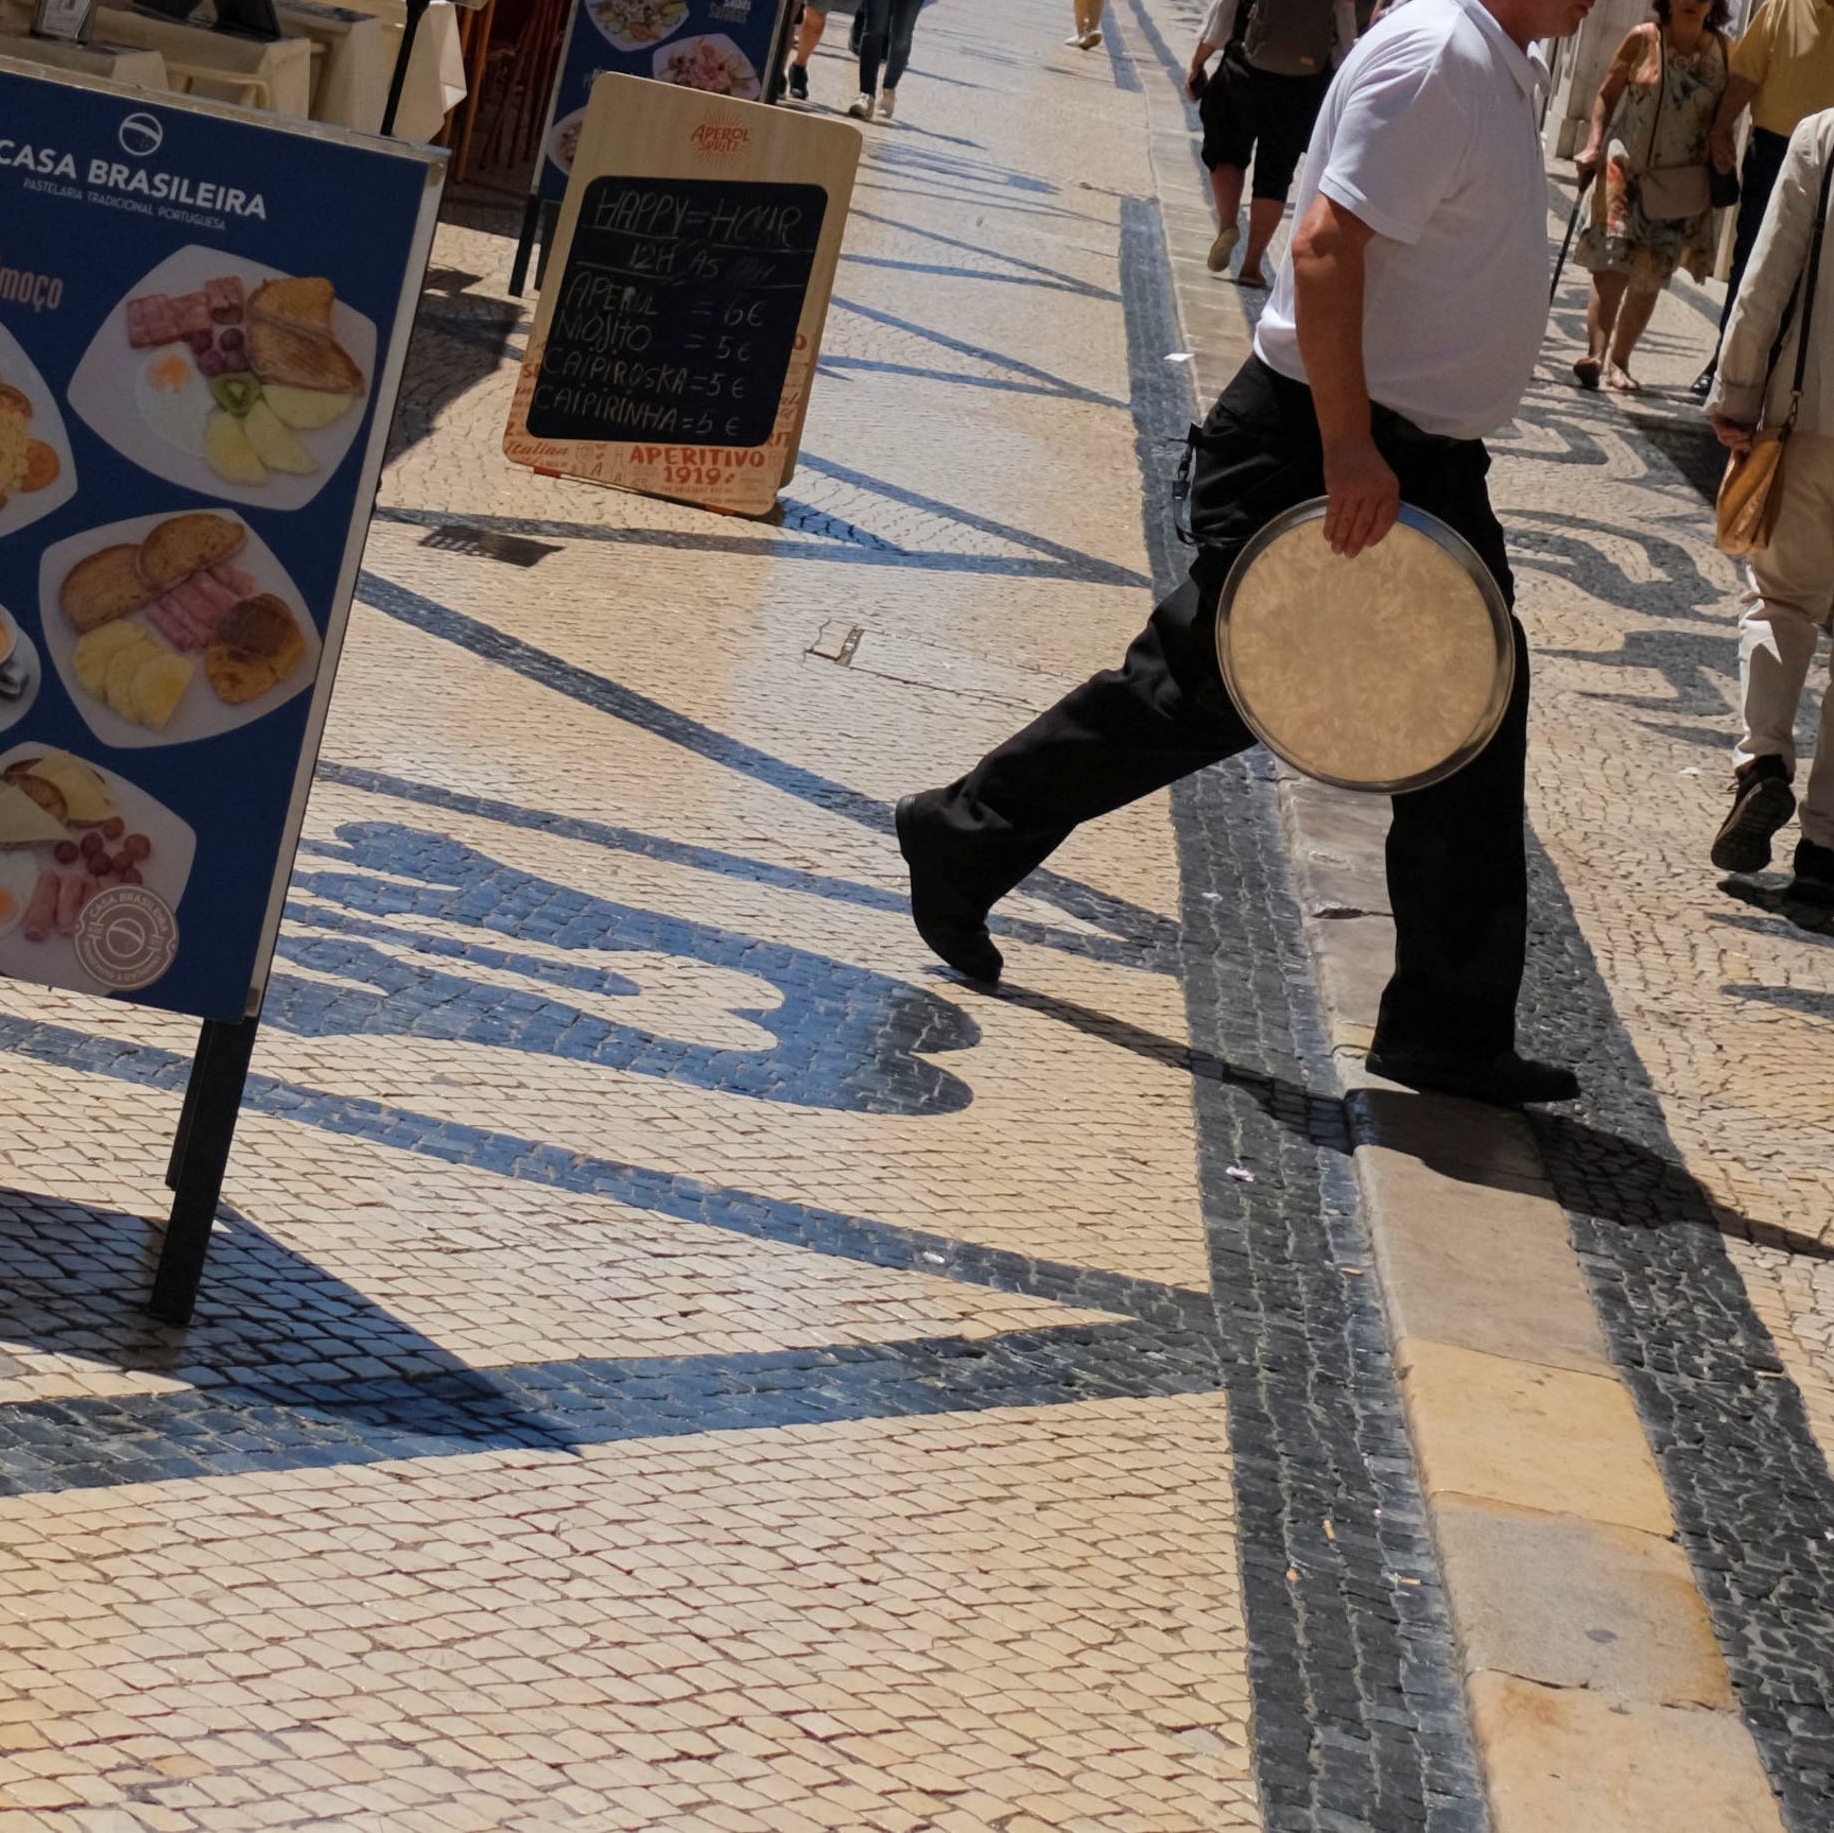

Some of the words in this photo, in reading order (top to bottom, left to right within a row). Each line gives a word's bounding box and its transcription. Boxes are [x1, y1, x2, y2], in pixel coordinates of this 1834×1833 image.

[690, 124, 751, 143] APEROL
[87, 159, 266, 220] BRASILEIRA
[23, 177, 83, 201] PASTELARIA
[86, 192, 154, 216] TRADICIONAL
[158, 207, 226, 231] PORTUGUESA
[630, 447, 765, 468] APERITIVO
[664, 467, 723, 485] 1919
